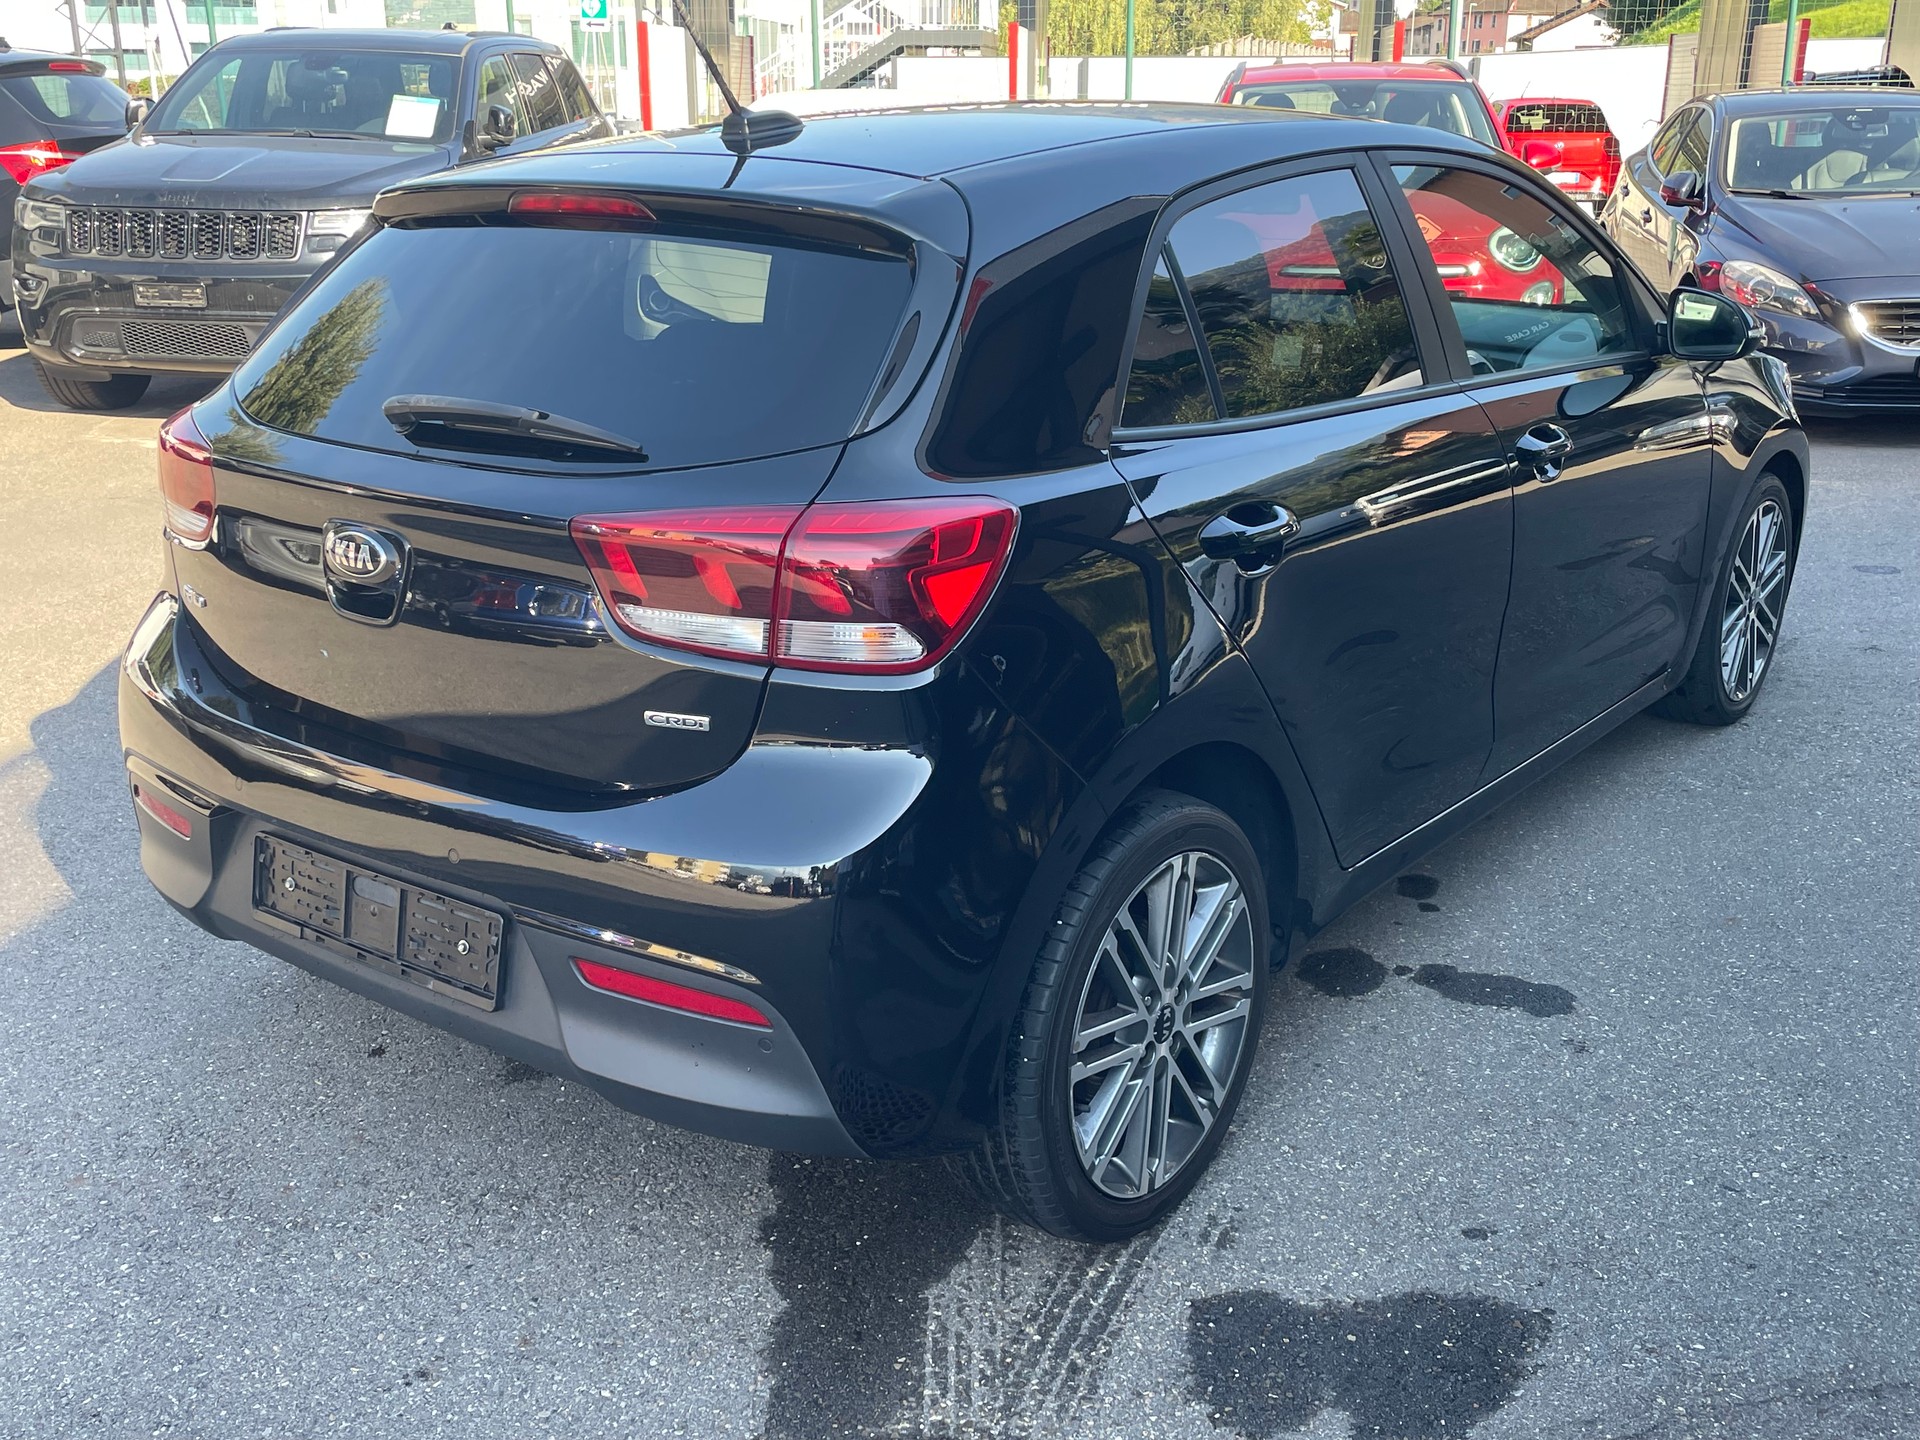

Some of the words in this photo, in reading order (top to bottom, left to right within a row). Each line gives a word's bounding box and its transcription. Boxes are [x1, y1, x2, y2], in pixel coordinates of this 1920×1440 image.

[334, 538, 375, 571] KIA
[648, 714, 704, 729] CRDi
[1161, 1007, 1172, 1042] KIA
